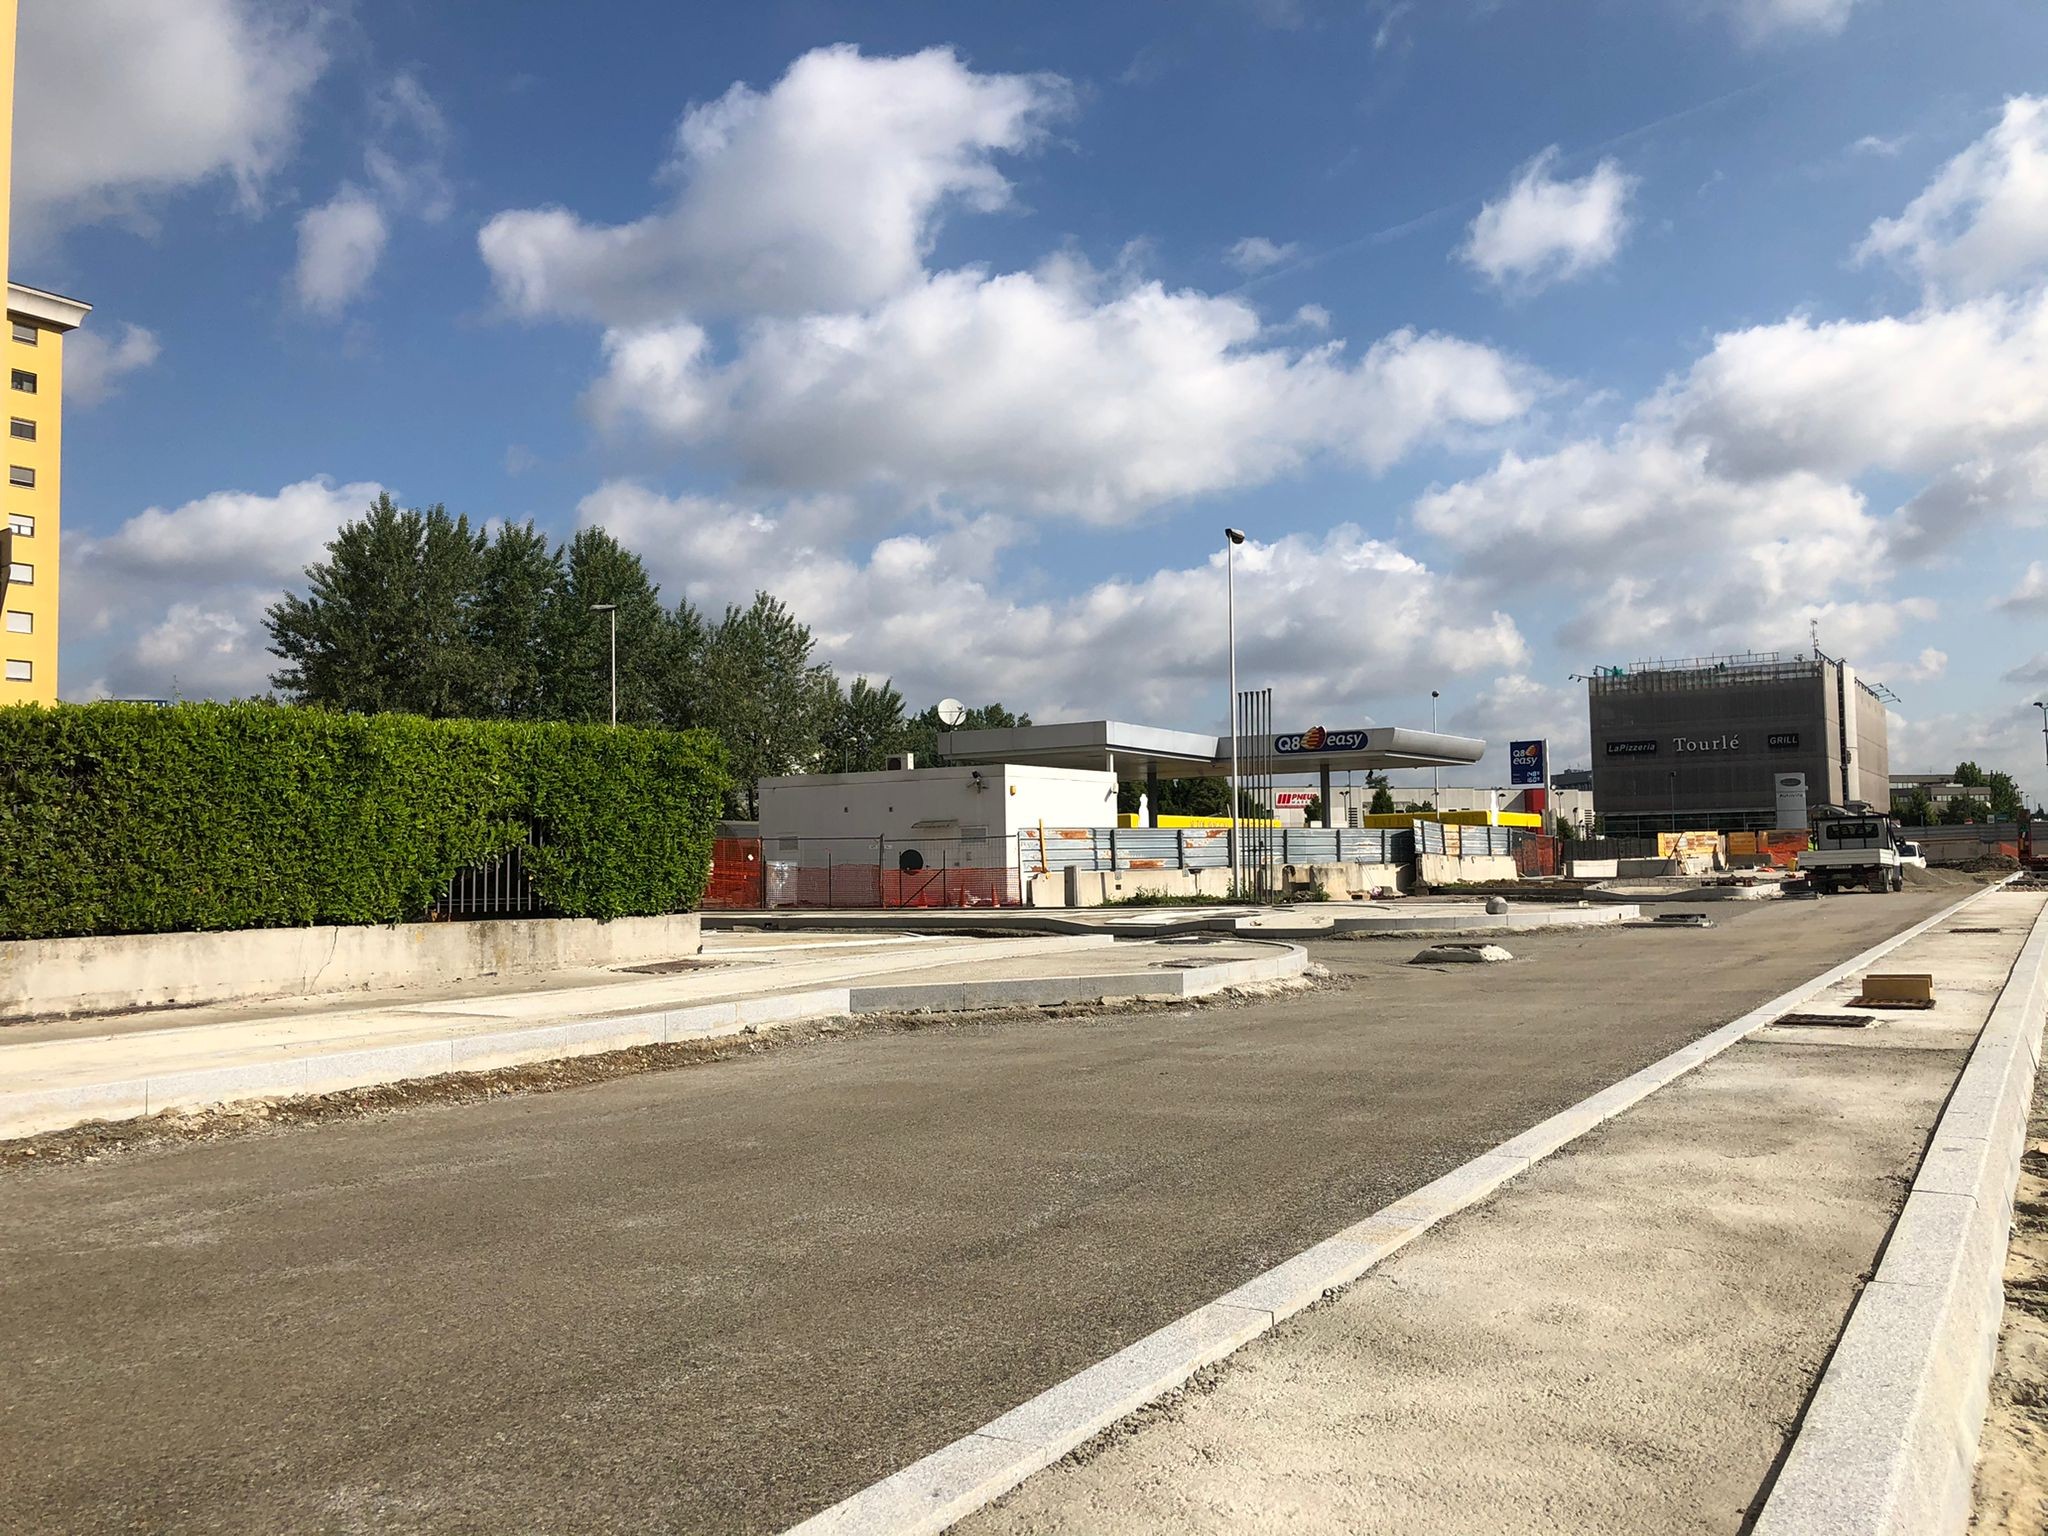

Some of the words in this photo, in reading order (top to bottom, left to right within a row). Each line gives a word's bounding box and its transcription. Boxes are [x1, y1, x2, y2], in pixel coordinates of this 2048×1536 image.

[1278, 736, 1300, 751] Q8
[1326, 733, 1363, 749] easy
[1672, 734, 1739, 752] Tourlé
[1769, 735, 1798, 745] GRILL
[1512, 749, 1525, 757] Q8
[1512, 756, 1538, 767] easy
